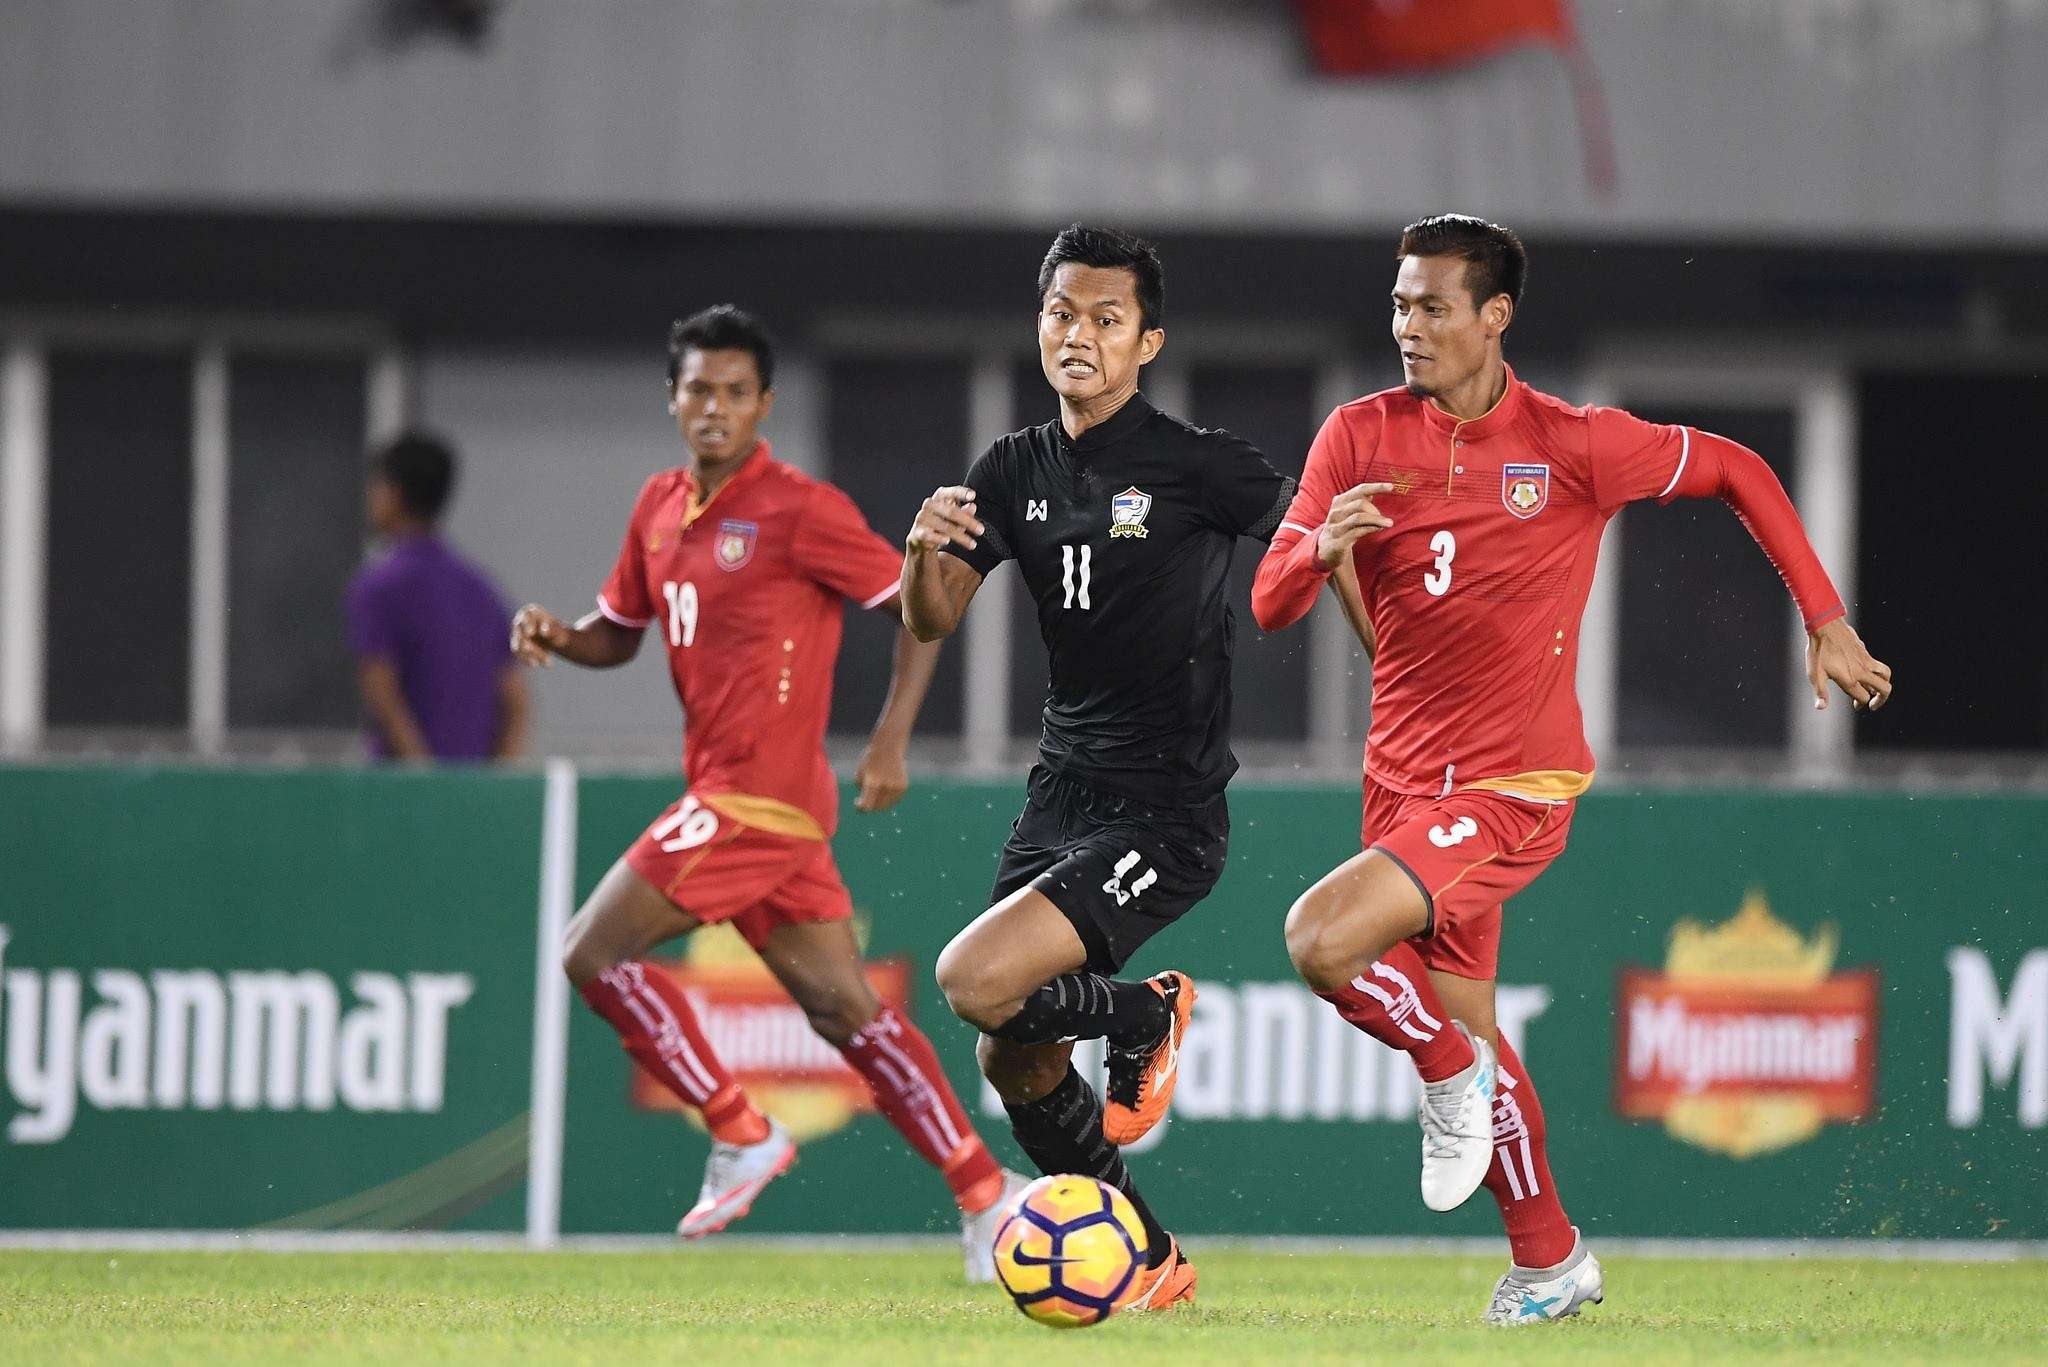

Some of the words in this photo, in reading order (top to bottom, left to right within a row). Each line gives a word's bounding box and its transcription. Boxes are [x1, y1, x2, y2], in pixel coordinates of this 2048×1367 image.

[1061, 544, 1091, 611] 11
[1424, 530, 1456, 597] 3
[662, 580, 699, 648] 19
[650, 794, 720, 853] 19
[1427, 815, 1479, 848] 3
[1113, 849, 1158, 898] 11
[0, 922, 474, 1144] yanmar
[1627, 994, 1866, 1093] Myanmar
